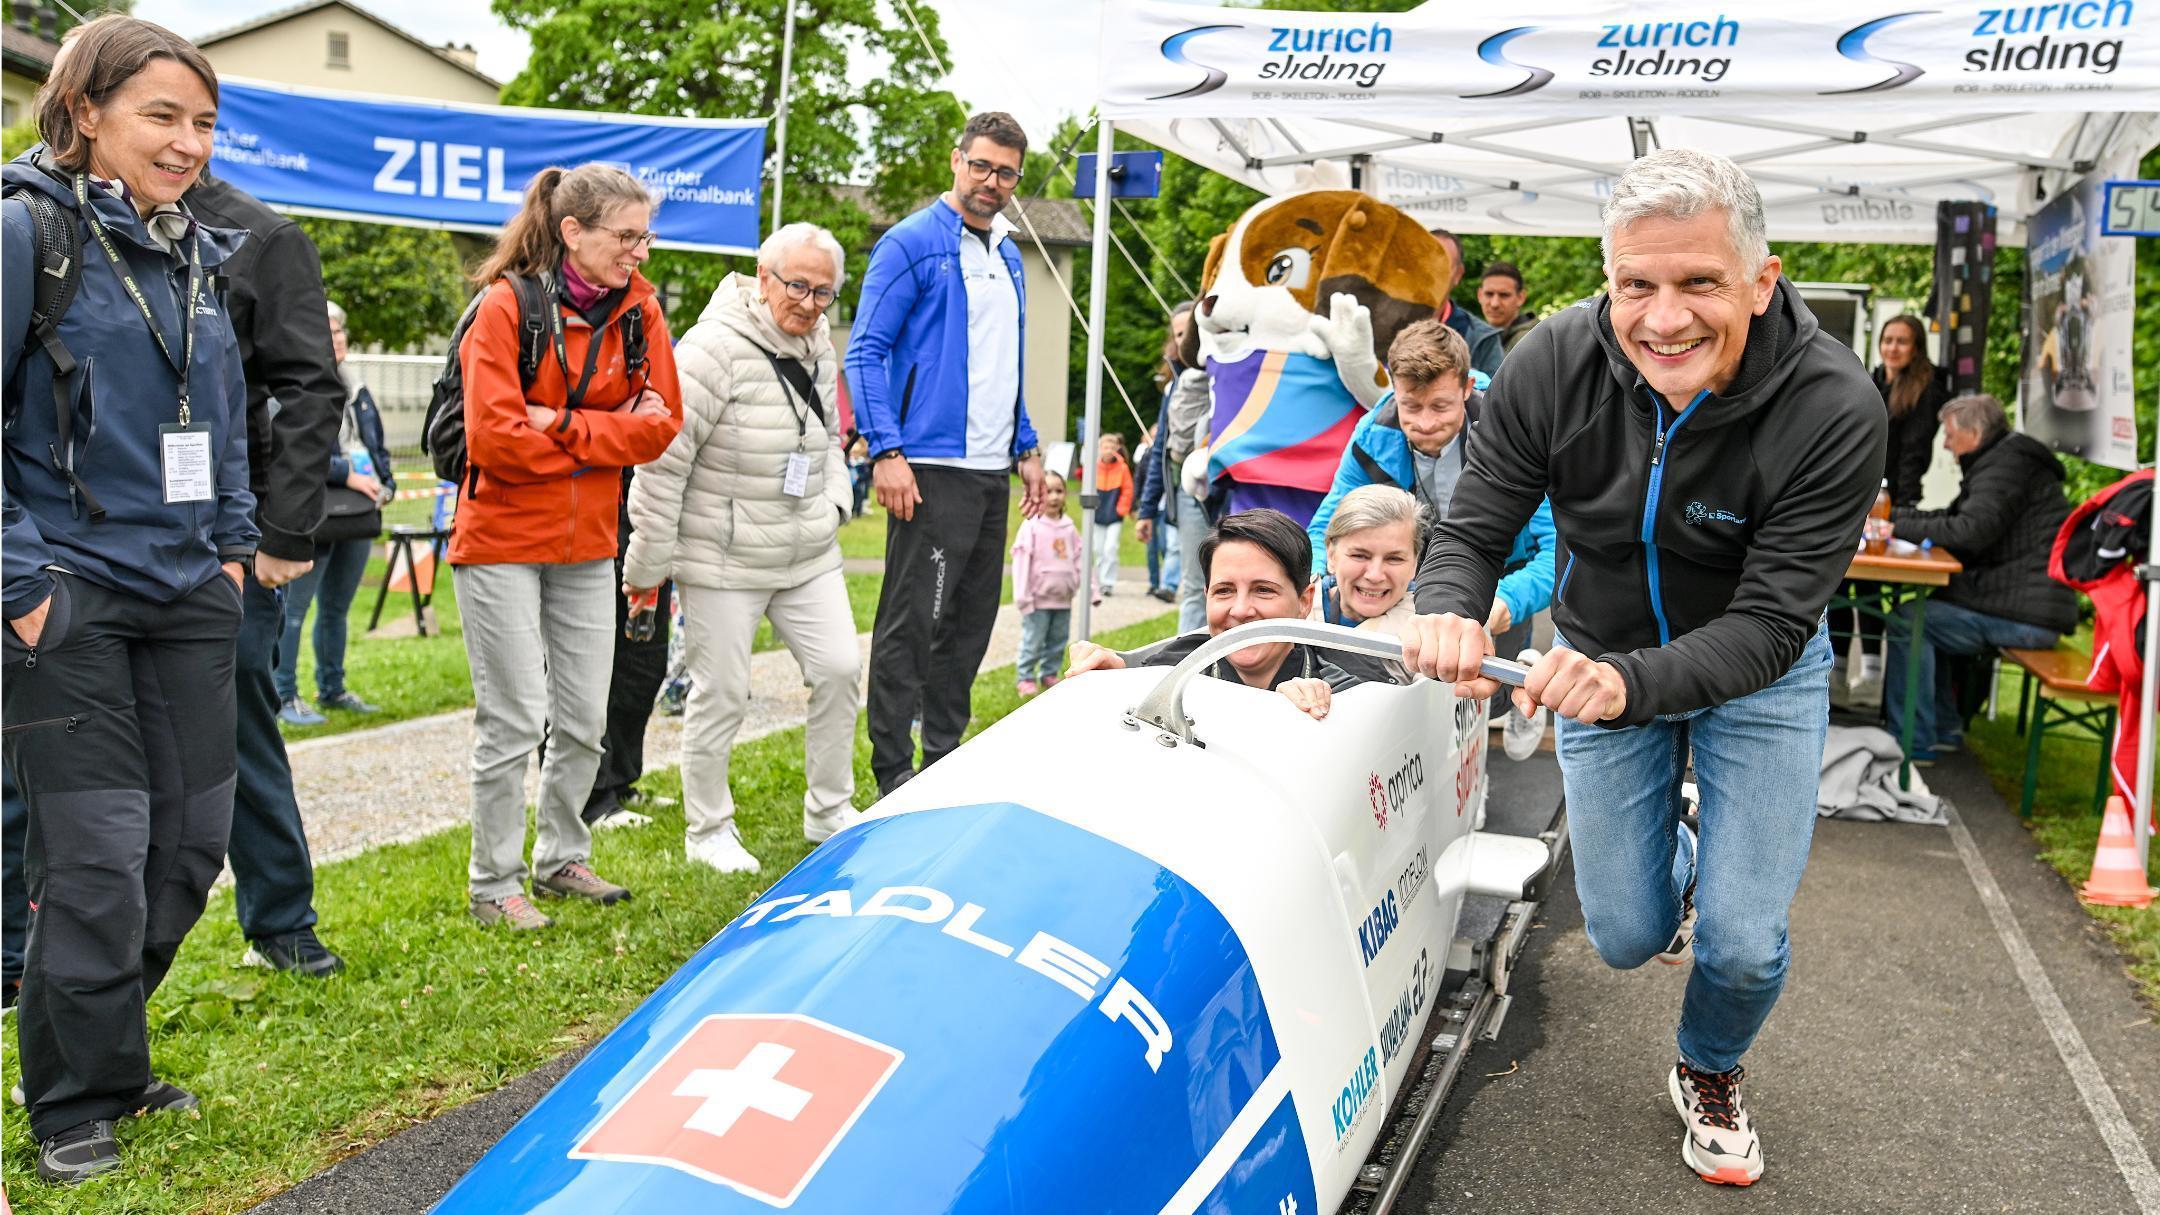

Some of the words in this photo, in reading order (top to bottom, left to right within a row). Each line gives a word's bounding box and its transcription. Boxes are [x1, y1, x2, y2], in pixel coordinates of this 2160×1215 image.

[1597, 15, 1739, 48] zurich
[1973, 0, 2133, 36] zurich
[1268, 22, 1392, 53] zurich
[1963, 35, 2123, 75] sliding
[1258, 55, 1386, 88] sliding
[1589, 50, 1731, 82] sliding
[1252, 91, 1272, 100] BOB
[1281, 91, 1329, 100] SKELETON
[1338, 92, 1376, 100] RODELN
[1579, 90, 1602, 99] BOB
[1612, 89, 1666, 99] SKELETON
[1676, 89, 1720, 98] RODELN
[212, 144, 309, 172] ntonalbank
[373, 136, 524, 205] ZIEL
[638, 166, 703, 186] Zürcher
[91, 219, 102, 238] COOL
[102, 241, 120, 263] CLEAN
[124, 276, 138, 293] COOL
[138, 297, 152, 319] CLEAN
[1388, 752, 1424, 818] aprica
[1358, 888, 1399, 969] KIBAG
[737, 886, 1173, 1075] TADLER
[1332, 1045, 1379, 1142] KOHLER
